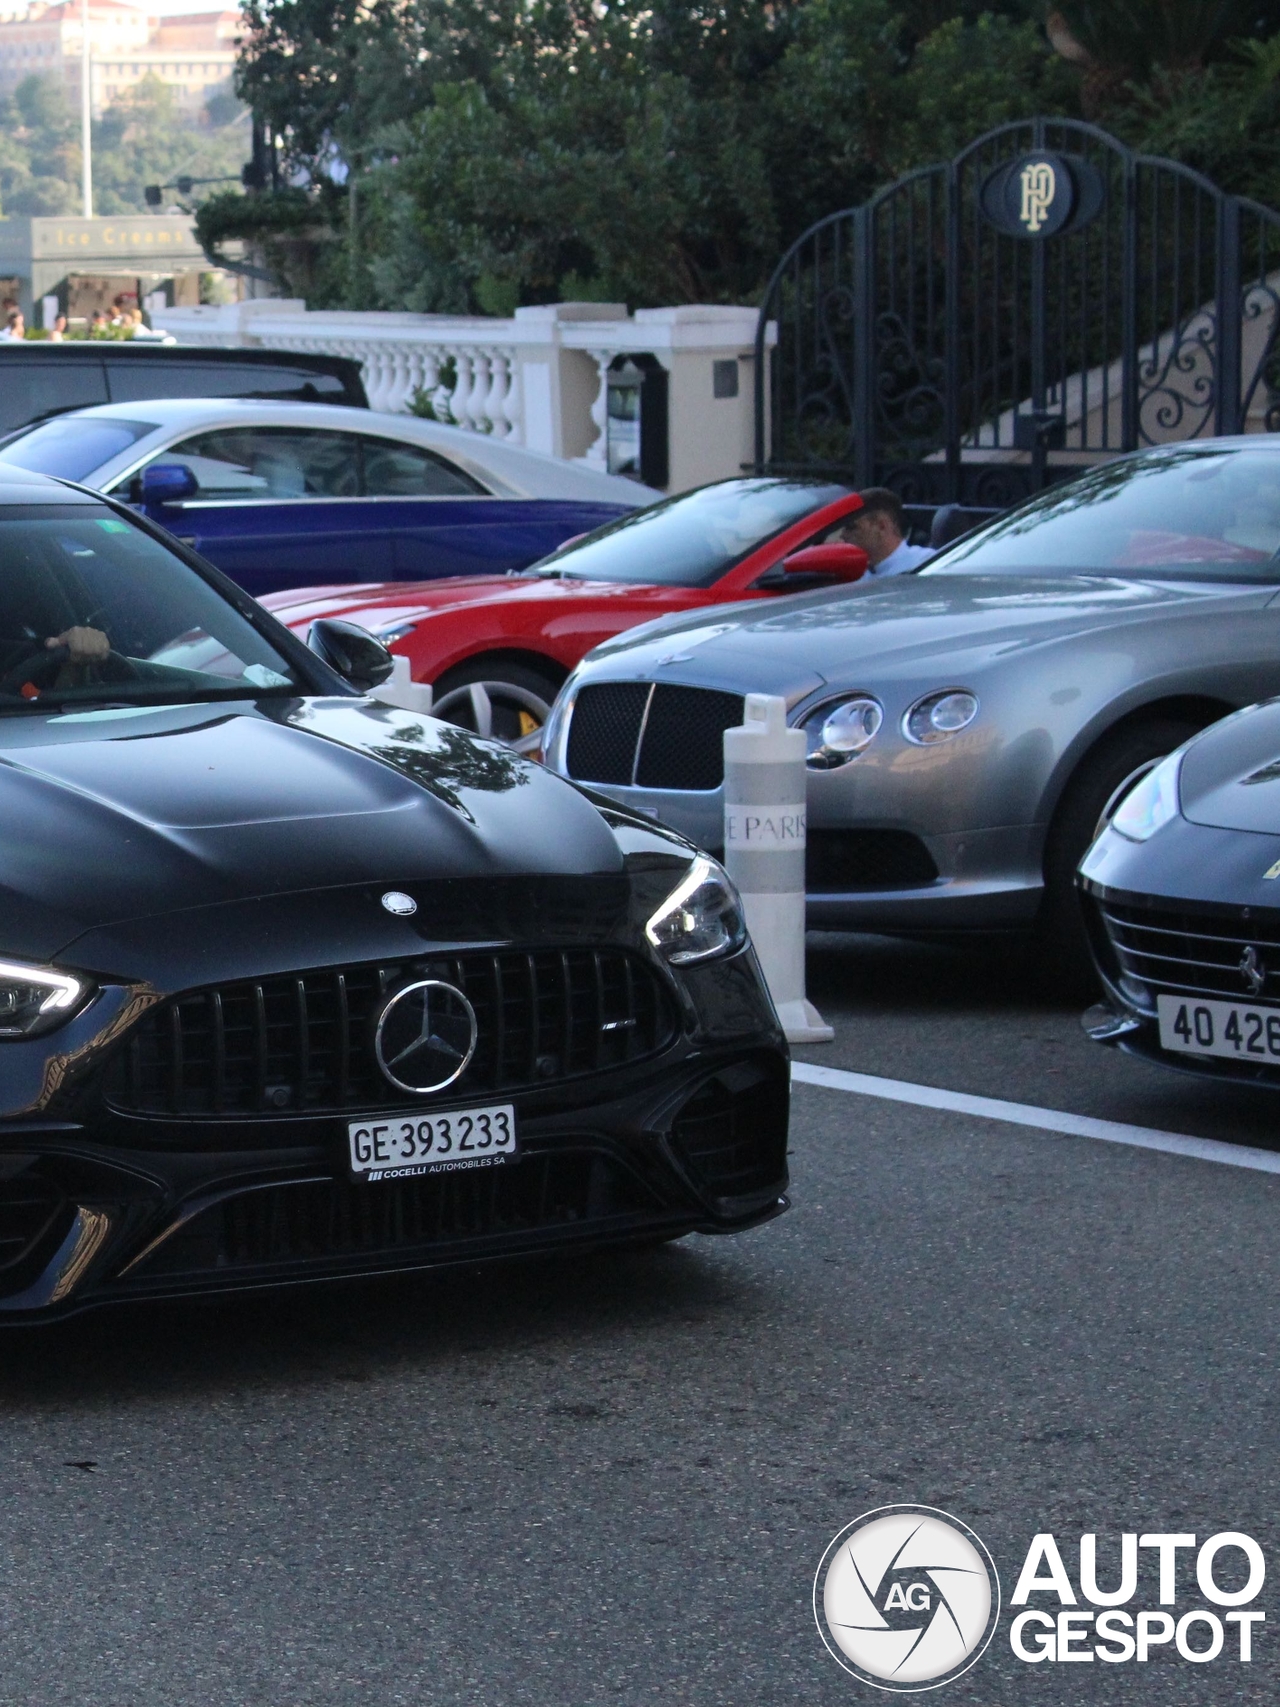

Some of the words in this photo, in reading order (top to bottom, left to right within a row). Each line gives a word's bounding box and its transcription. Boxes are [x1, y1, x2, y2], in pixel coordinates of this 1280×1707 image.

[57, 227, 91, 246] Ice
[102, 226, 184, 245] Creams
[1173, 1004, 1215, 1047] 40
[383, 1166, 427, 1179] COCELLI
[428, 1158, 492, 1174] AUTOMOBILES
[493, 1156, 506, 1165] SA
